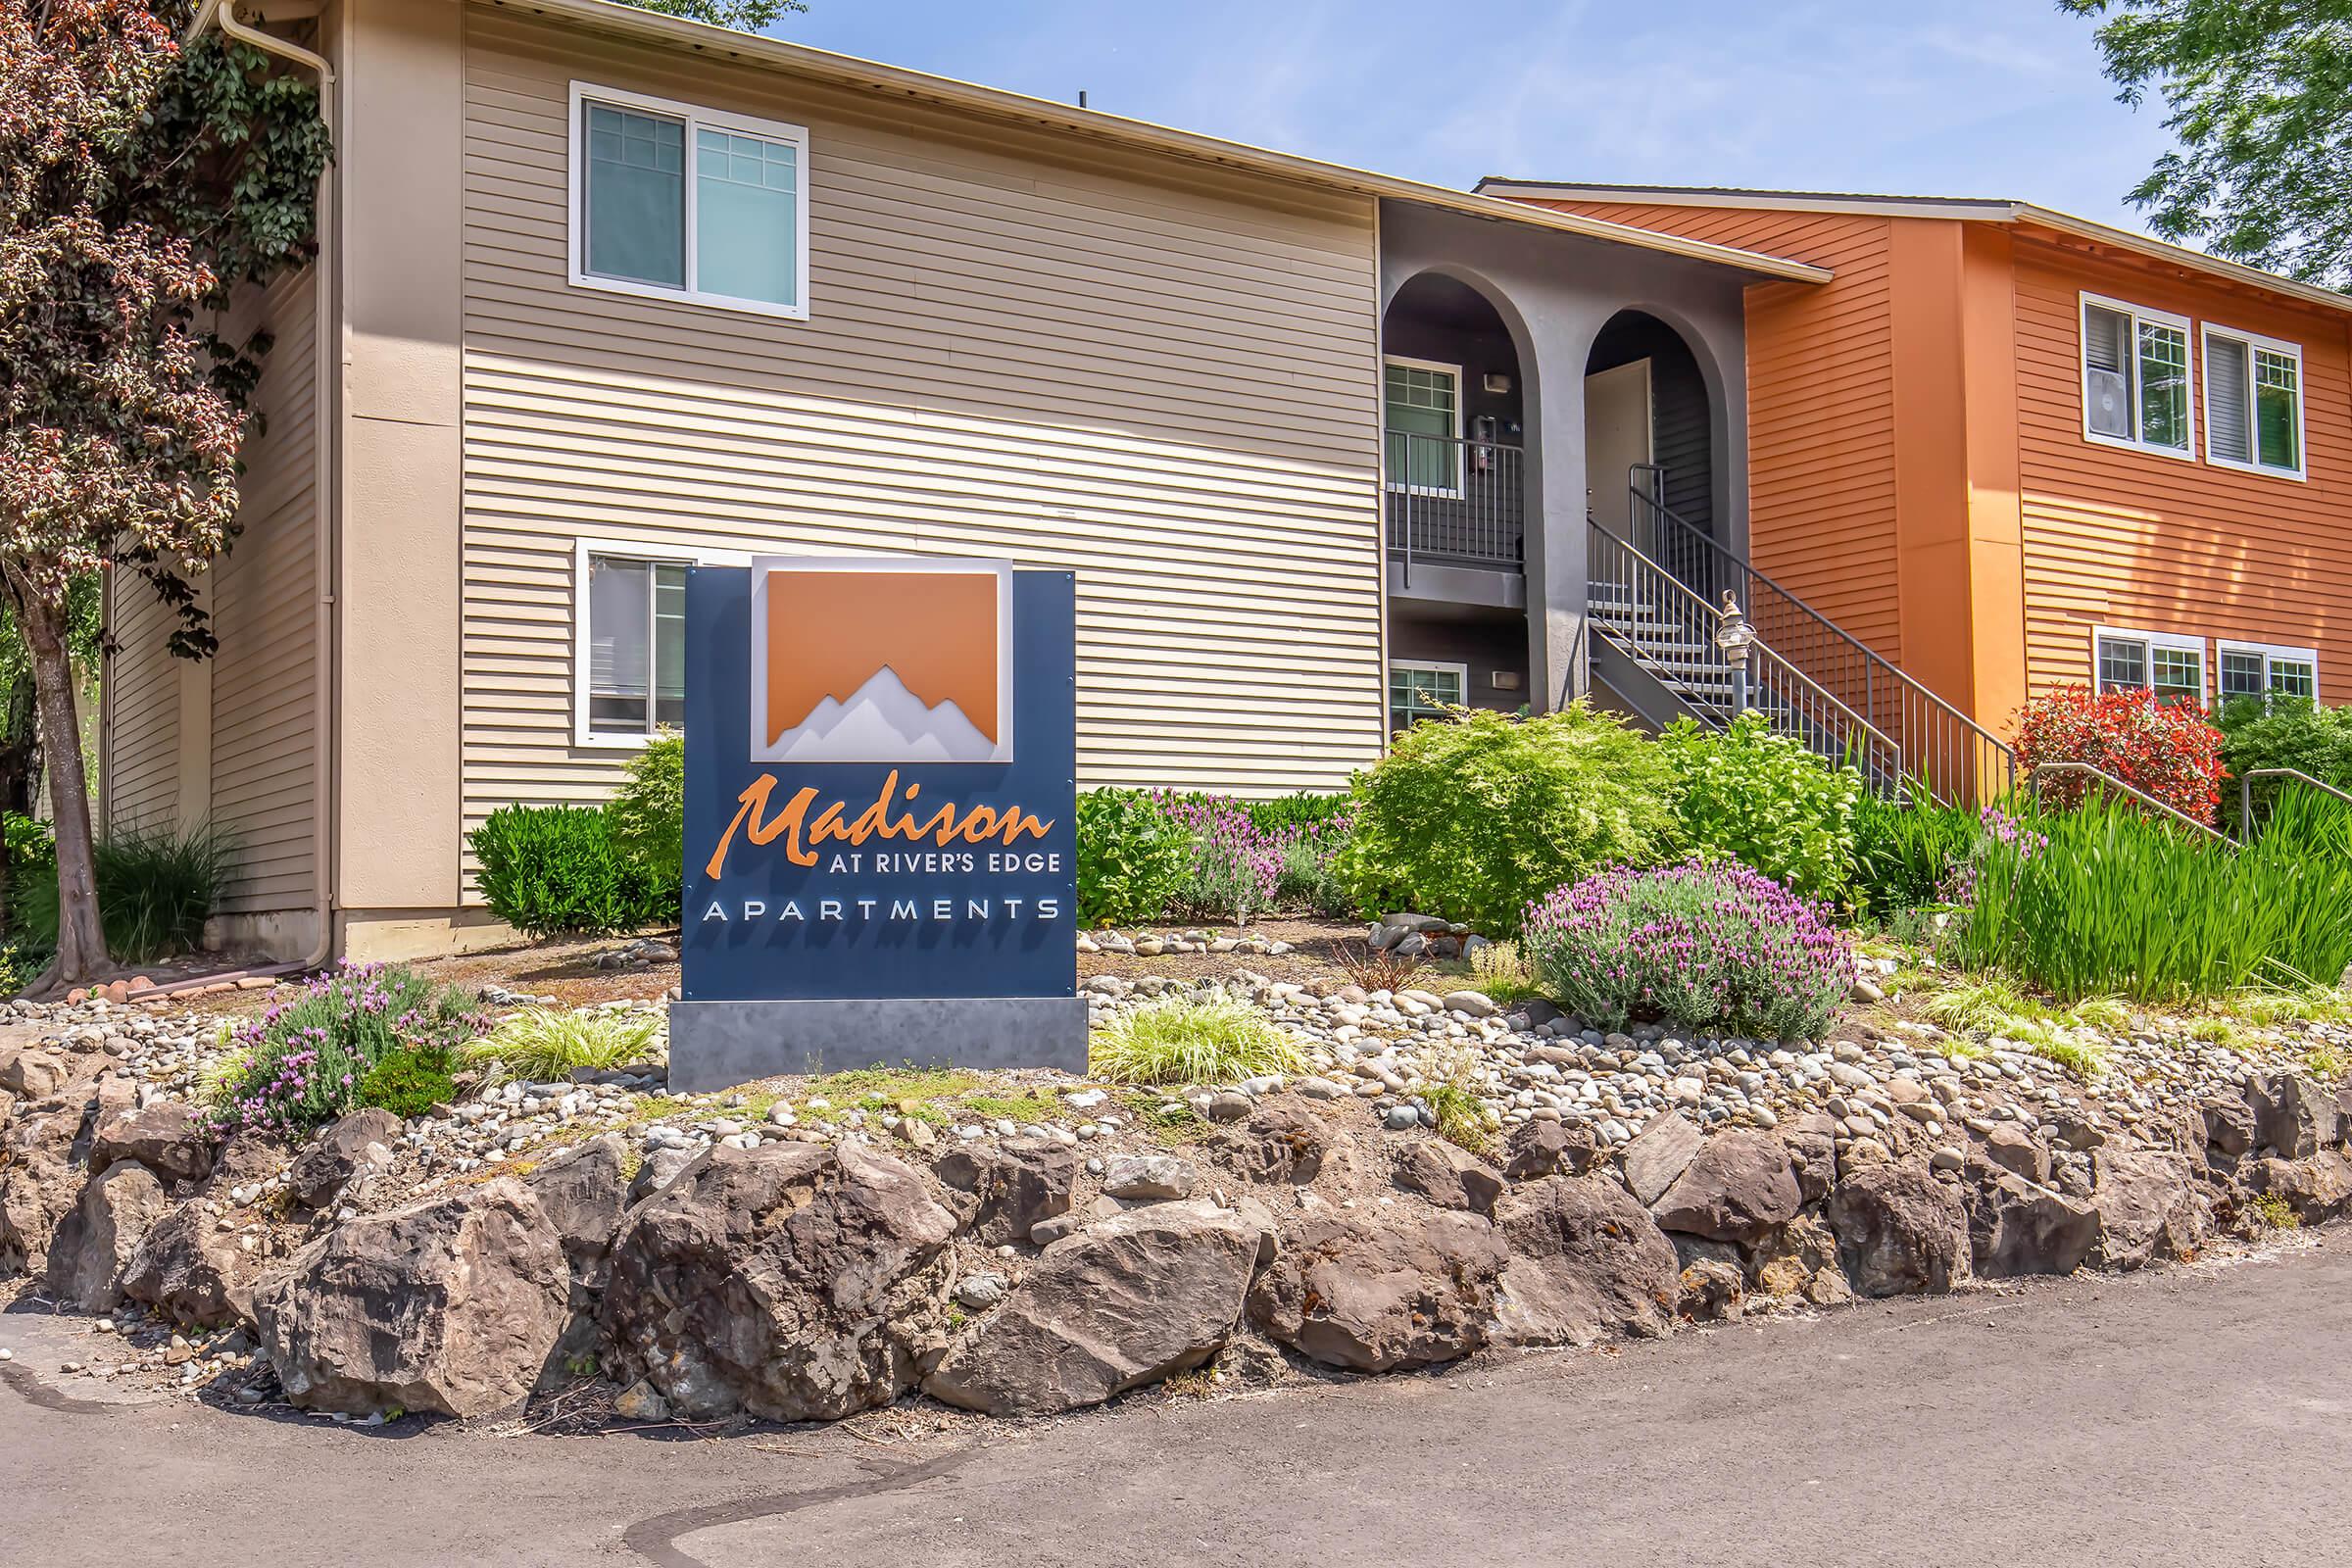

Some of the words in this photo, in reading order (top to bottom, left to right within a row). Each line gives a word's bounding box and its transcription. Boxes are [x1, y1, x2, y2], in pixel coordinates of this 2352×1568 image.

[706, 769, 1055, 880] Madison
[829, 855, 861, 874] AT
[876, 853, 974, 873] RIVER'S
[988, 853, 1060, 873] EDGE
[702, 899, 1059, 922] APARTMENTS
